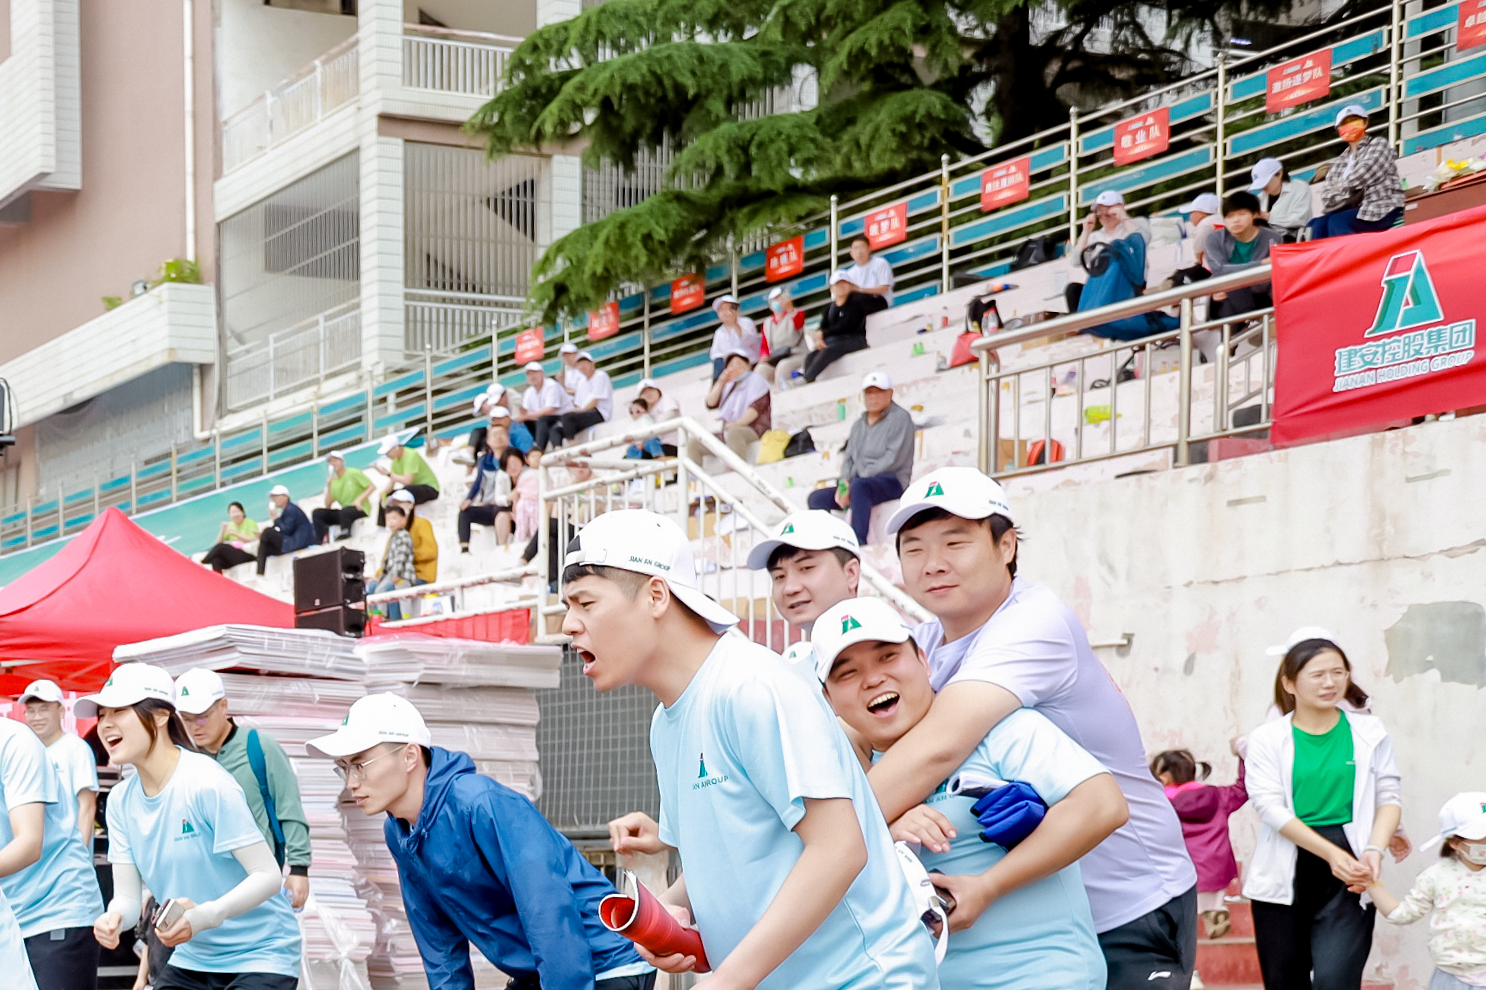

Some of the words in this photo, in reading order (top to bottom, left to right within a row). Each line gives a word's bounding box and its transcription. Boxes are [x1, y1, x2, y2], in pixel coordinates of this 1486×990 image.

[1333, 370, 1376, 392] JIANAN
[1377, 360, 1429, 383] HOLDING
[1431, 350, 1475, 372] GROUP
[1334, 318, 1476, 376] 建安控股集团
